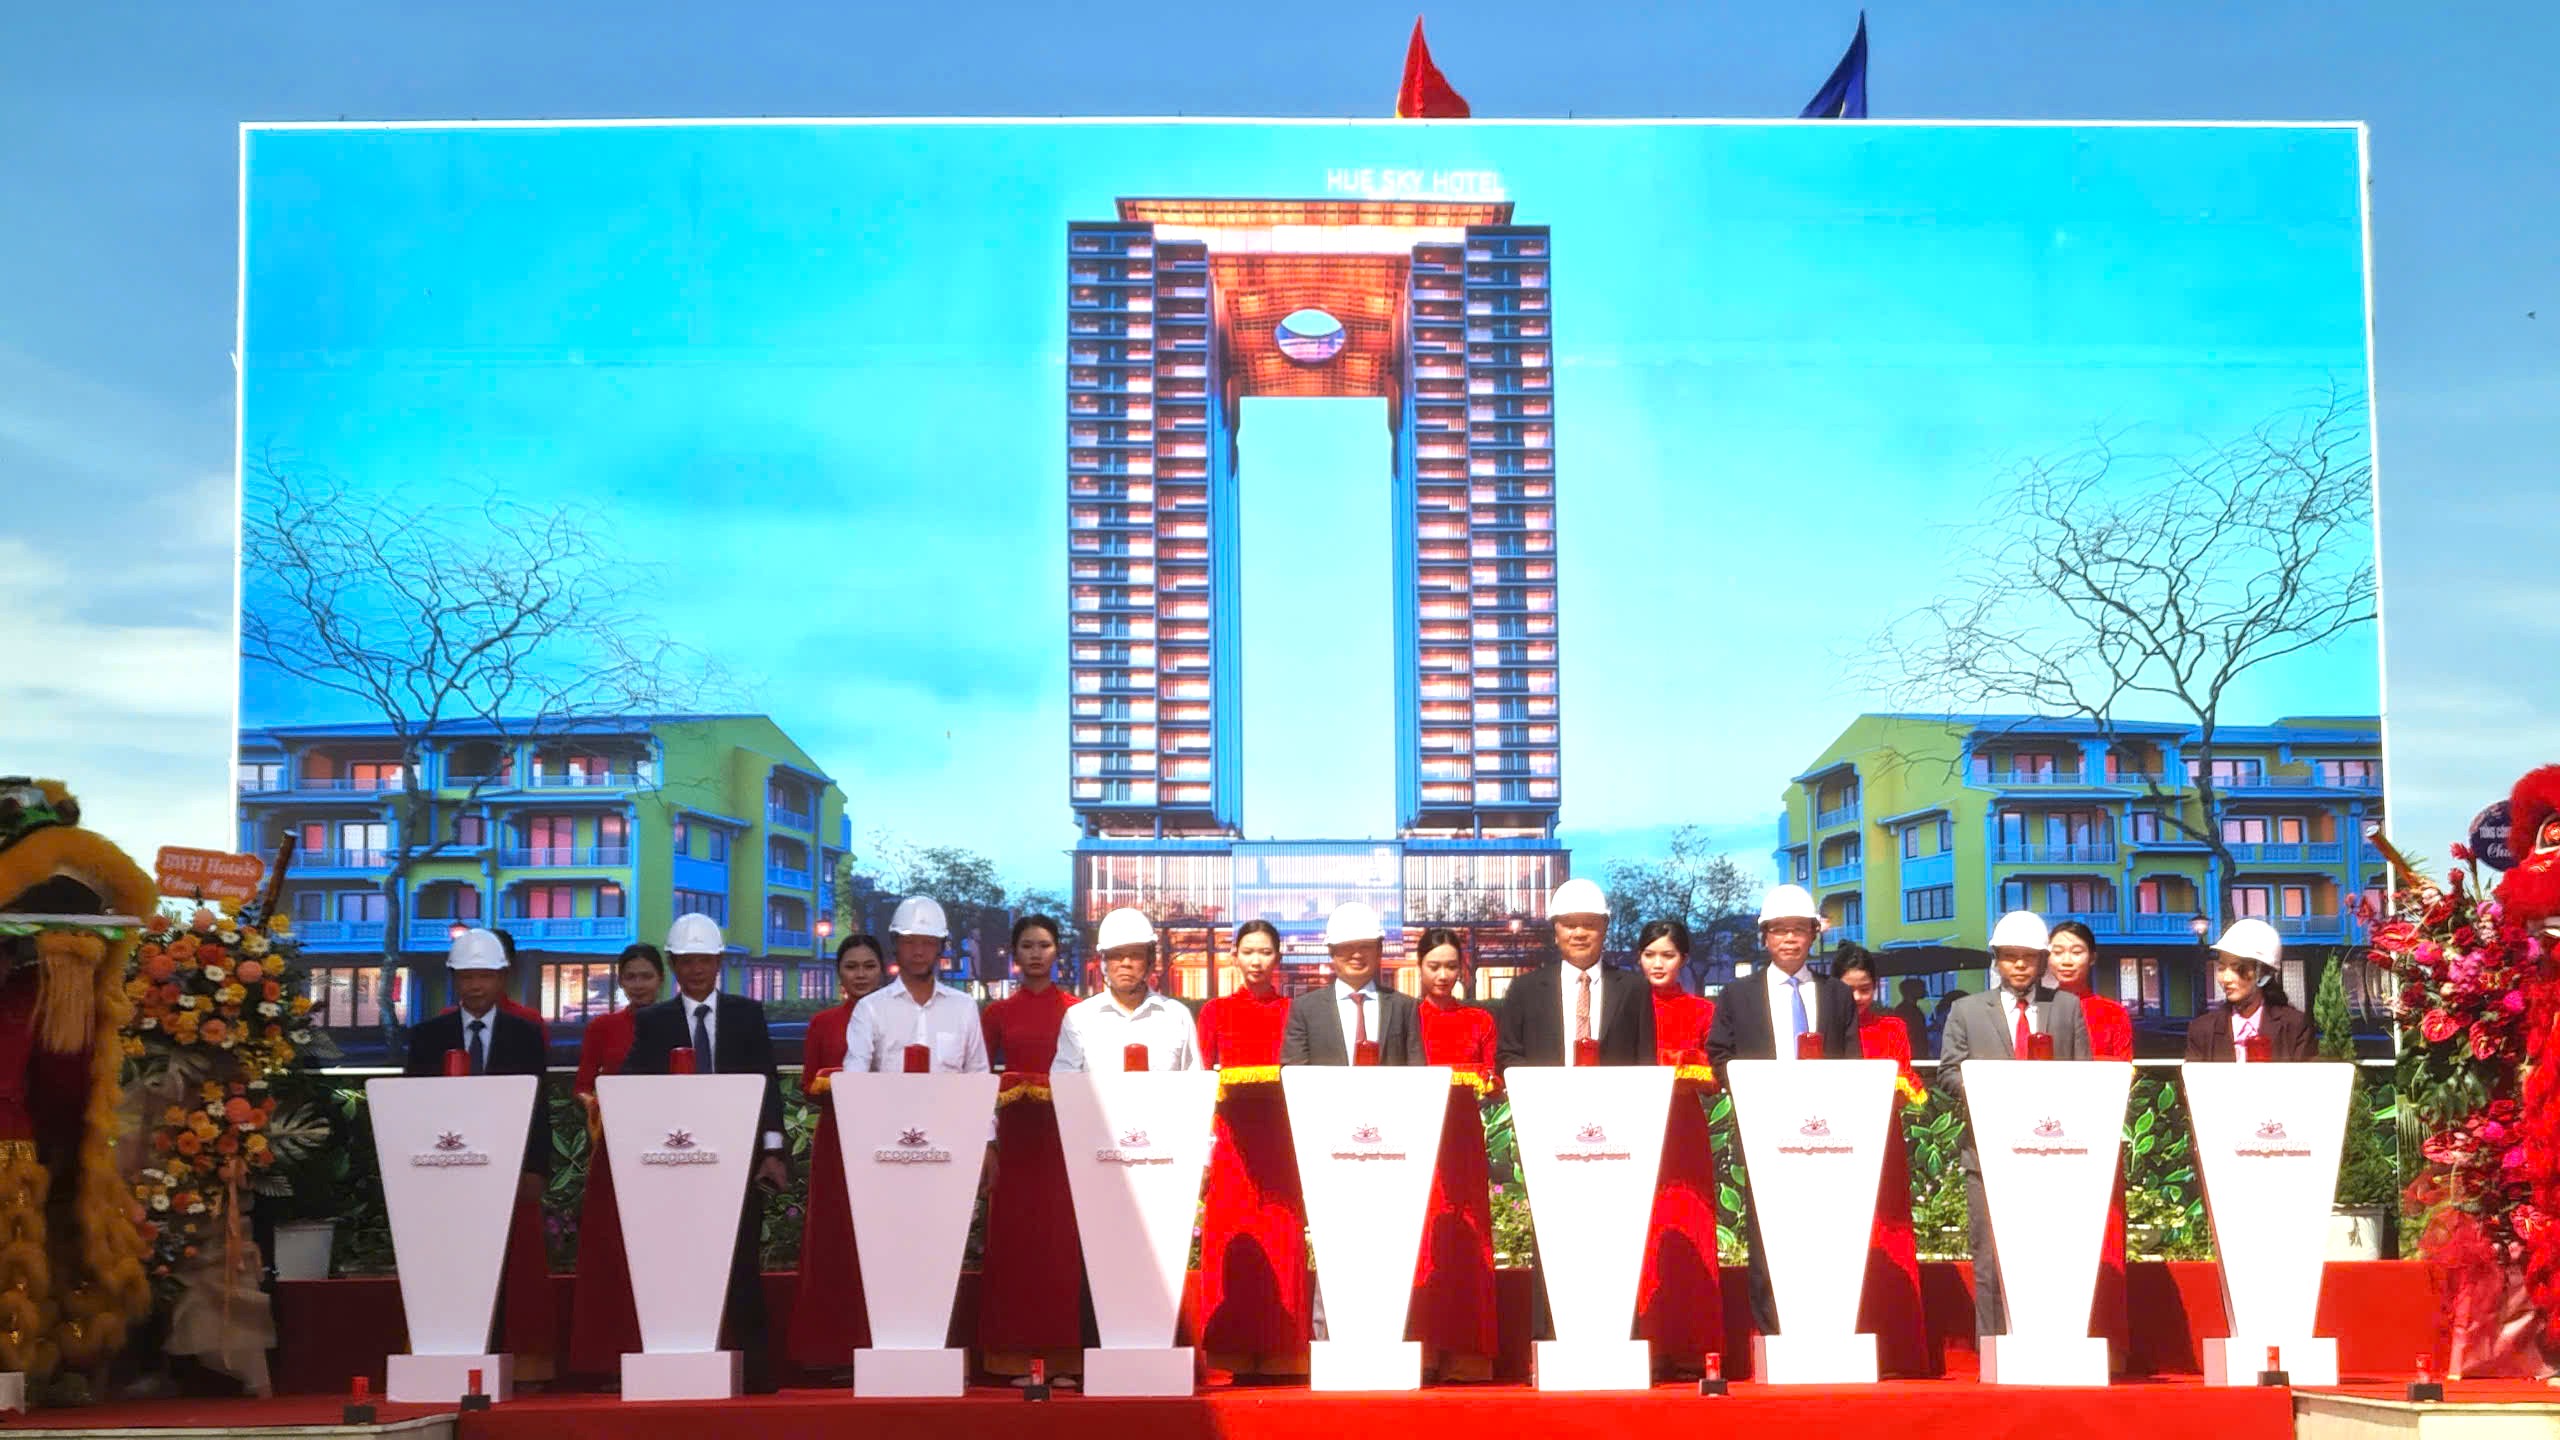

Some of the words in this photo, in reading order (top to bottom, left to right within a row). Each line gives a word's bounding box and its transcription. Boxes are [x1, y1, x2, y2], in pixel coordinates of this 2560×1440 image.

[1327, 167, 1374, 192] HUE
[1382, 168, 1426, 193] SKY
[1433, 170, 1505, 194] HOTEL
